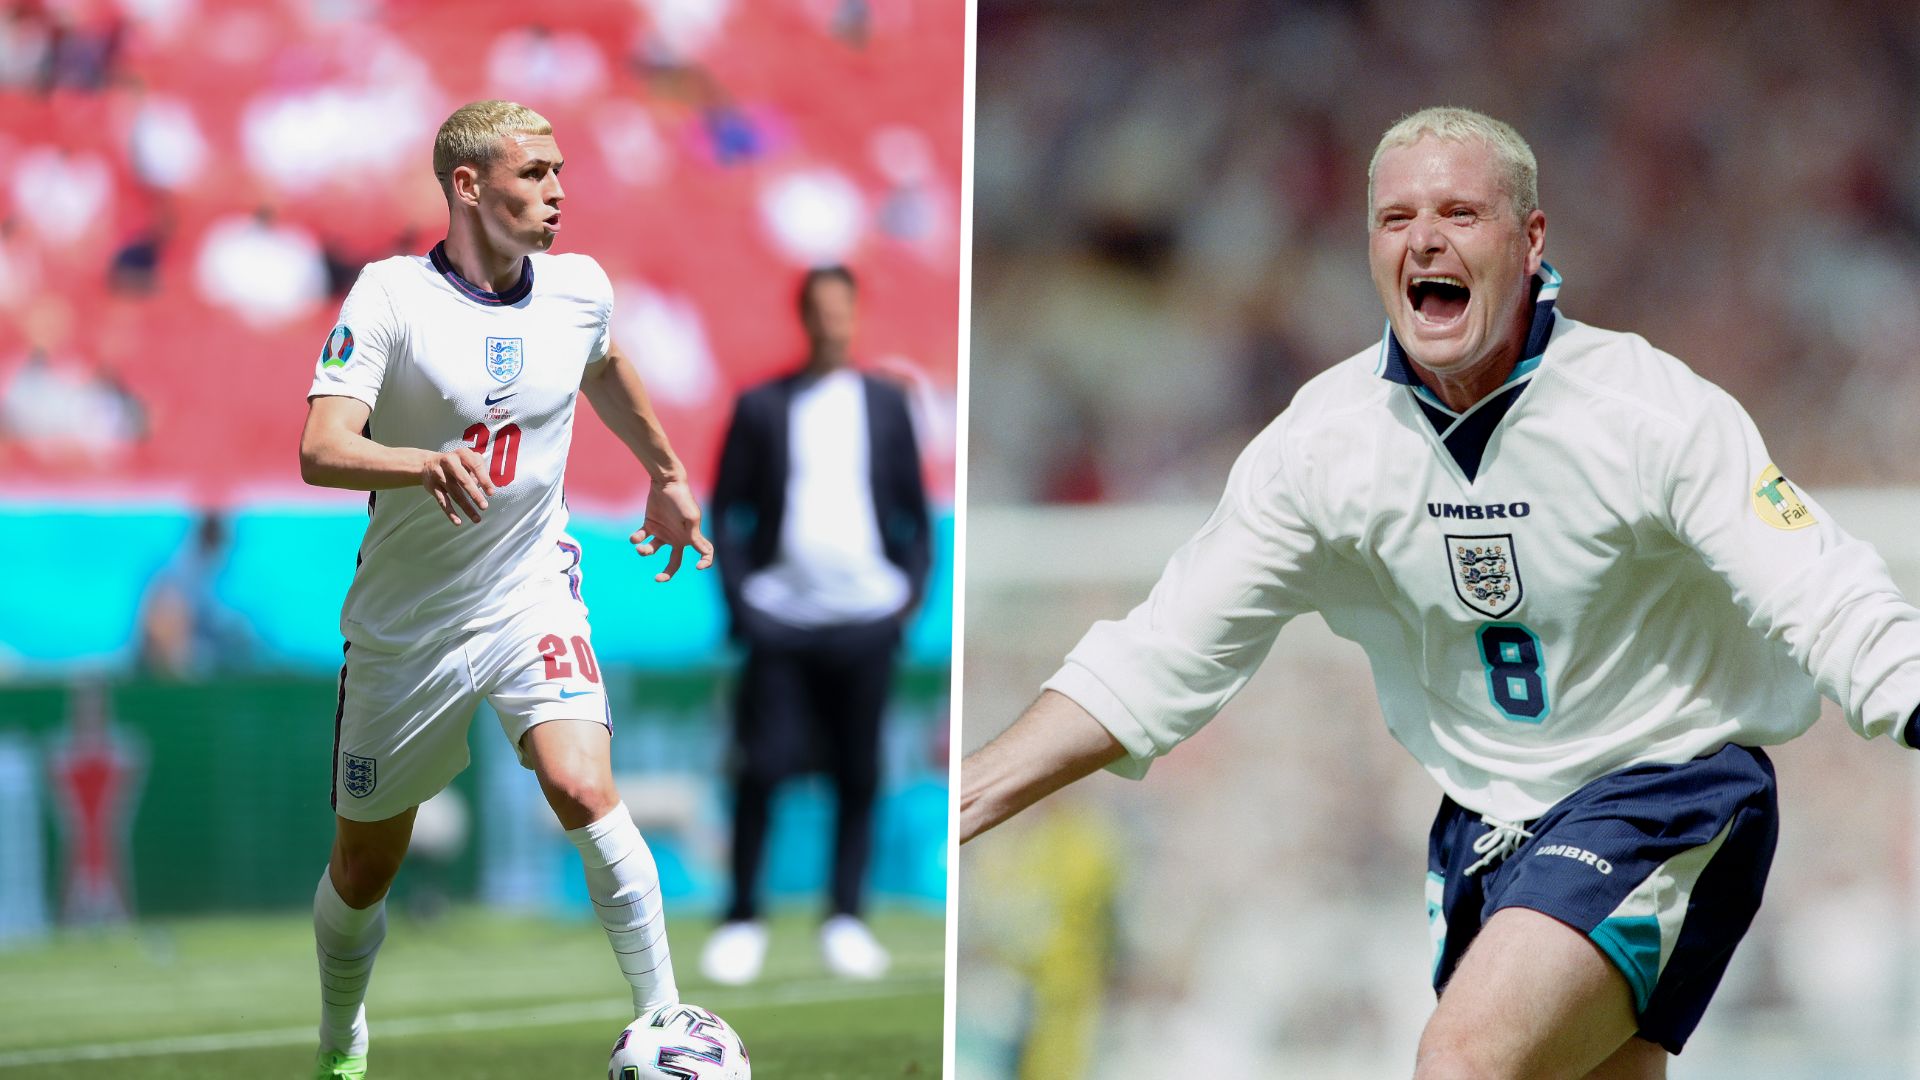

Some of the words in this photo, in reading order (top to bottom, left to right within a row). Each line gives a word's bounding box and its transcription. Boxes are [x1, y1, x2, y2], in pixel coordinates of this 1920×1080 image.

[1427, 501, 1531, 520] UMBRO
[537, 633, 599, 684] 20
[1475, 621, 1552, 725] 8
[1535, 844, 1613, 875] UMBRO
